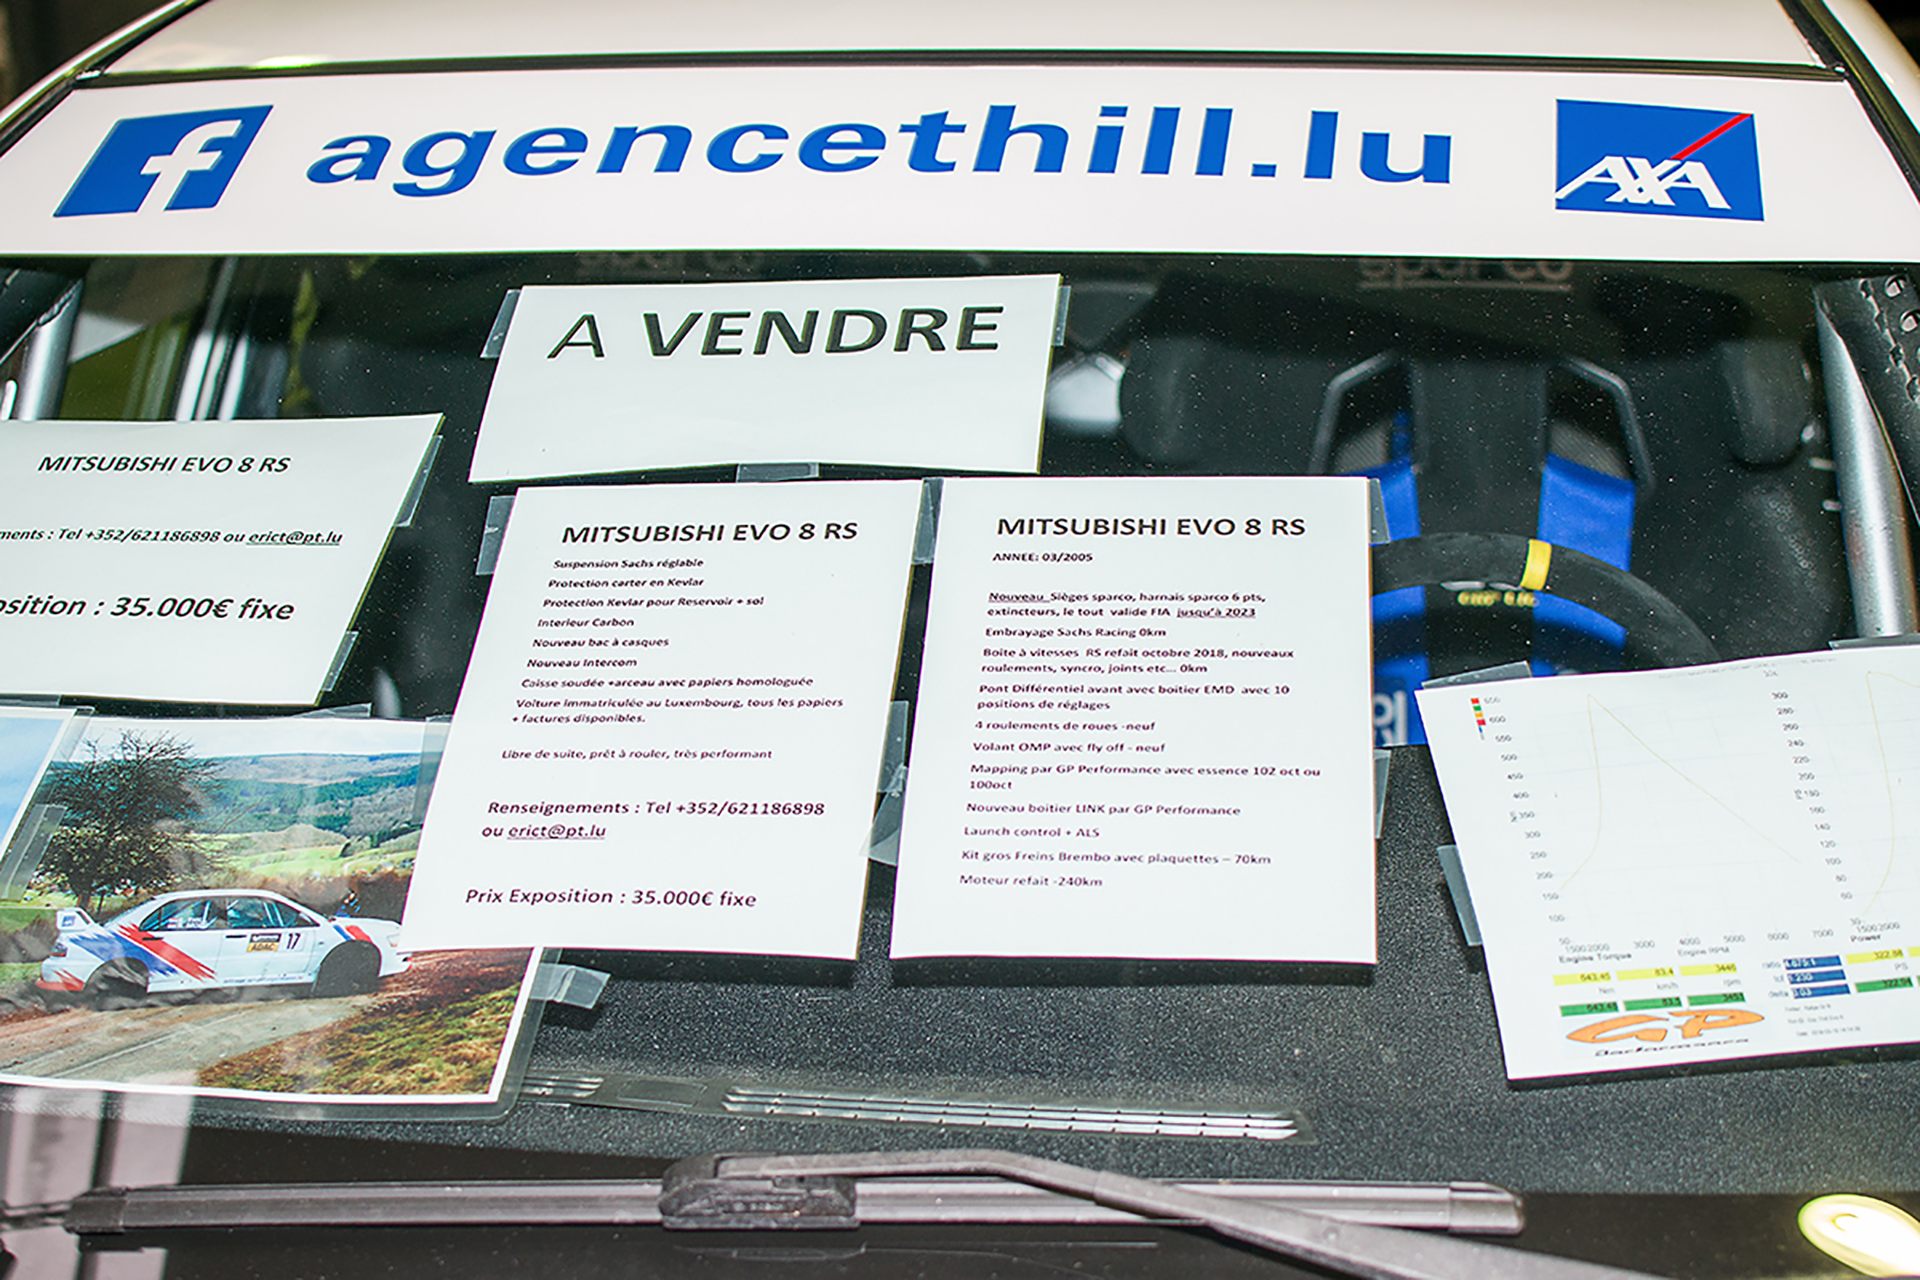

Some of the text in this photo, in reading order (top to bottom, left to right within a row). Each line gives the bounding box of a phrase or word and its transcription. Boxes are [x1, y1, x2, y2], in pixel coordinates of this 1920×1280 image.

[307, 105, 1451, 196] agencethill.lu
[547, 305, 1004, 359] A VENDRE
[37, 456, 291, 473] MITSUBISHI EVO 8 RS
[997, 517, 1305, 536] MITSUBISHI EVO 8 RS
[58, 528, 83, 540] Tel
[85, 528, 221, 542] +352/621186898
[222, 533, 246, 542] ou
[246, 530, 342, 545] erict@pt.lu
[561, 522, 857, 543] MITSUBISHI EVO 8 RS
[992, 552, 1093, 562] ANNEE: 03/2005
[553, 558, 704, 570] Suspension Sachs réglable
[548, 579, 609, 588] Protection
[611, 579, 647, 587] carter
[666, 577, 704, 586] Kevlar
[542, 596, 764, 608] Protection Kevlar pour Reservoir sol
[988, 592, 1266, 603] Nouveau Sièges sparco, harnais sparco 6 pts,
[110, 596, 234, 618] 35.000€
[238, 597, 294, 620] fixe
[986, 606, 1060, 617] extincteurs,
[1063, 607, 1074, 616] le
[1077, 608, 1103, 616] tout
[1109, 607, 1147, 616] valide
[1150, 607, 1170, 616] FIA
[1225, 607, 1255, 616] 2023
[537, 617, 634, 627] Interieur Carbon
[985, 627, 1166, 638] Embrayage Sachs Racing 0km
[532, 637, 669, 648] Nouveau bac à casques
[1018, 648, 1026, 657] à
[1029, 648, 1079, 657] vitesses
[1085, 647, 1101, 657] RS
[1104, 648, 1138, 657] refait
[1141, 648, 1190, 658] octobre
[1193, 648, 1228, 658] 2018,
[526, 658, 637, 668] Nouveau Intercom
[981, 663, 1208, 674] roulements, syncro, joints 0km
[521, 678, 558, 688] Caisse
[561, 678, 604, 687] soudée
[687, 677, 733, 688] papiers
[736, 677, 813, 687] homologuée
[979, 684, 1008, 693] Pont
[1087, 685, 1122, 693] avant
[1126, 686, 1154, 694] avec
[1203, 685, 1235, 694] EMD
[1275, 685, 1290, 694] 10
[516, 698, 561, 708] Voiture
[563, 698, 644, 707] immatriculée
[747, 698, 774, 707] tous
[776, 697, 794, 707] les
[796, 698, 843, 708] papiers
[976, 699, 1110, 711] positions de réglages
[521, 713, 645, 724] factures disponibles.
[974, 720, 983, 729] 4
[986, 720, 1060, 730] roulements
[1062, 721, 1079, 730] de
[972, 742, 1014, 751] Volant
[1018, 742, 1051, 752] OMP
[1087, 743, 1103, 753] fly
[1105, 743, 1124, 752] off
[1135, 743, 1165, 752] neuf
[501, 748, 772, 760] Libre de suite, prêt à rouler, très performant
[970, 764, 1028, 774] Mapping
[1030, 766, 1052, 774] par
[1055, 764, 1074, 774] GP
[1078, 764, 1161, 774] Performance
[1254, 766, 1276, 776] 102
[1279, 768, 1300, 776] oct
[970, 780, 1012, 789] 100oct
[487, 800, 825, 816] Renseignements Tel +352/621186898
[481, 824, 606, 840] ou erict@pt.lu
[465, 888, 756, 907] Prix Exposition 35.000€ fixe
